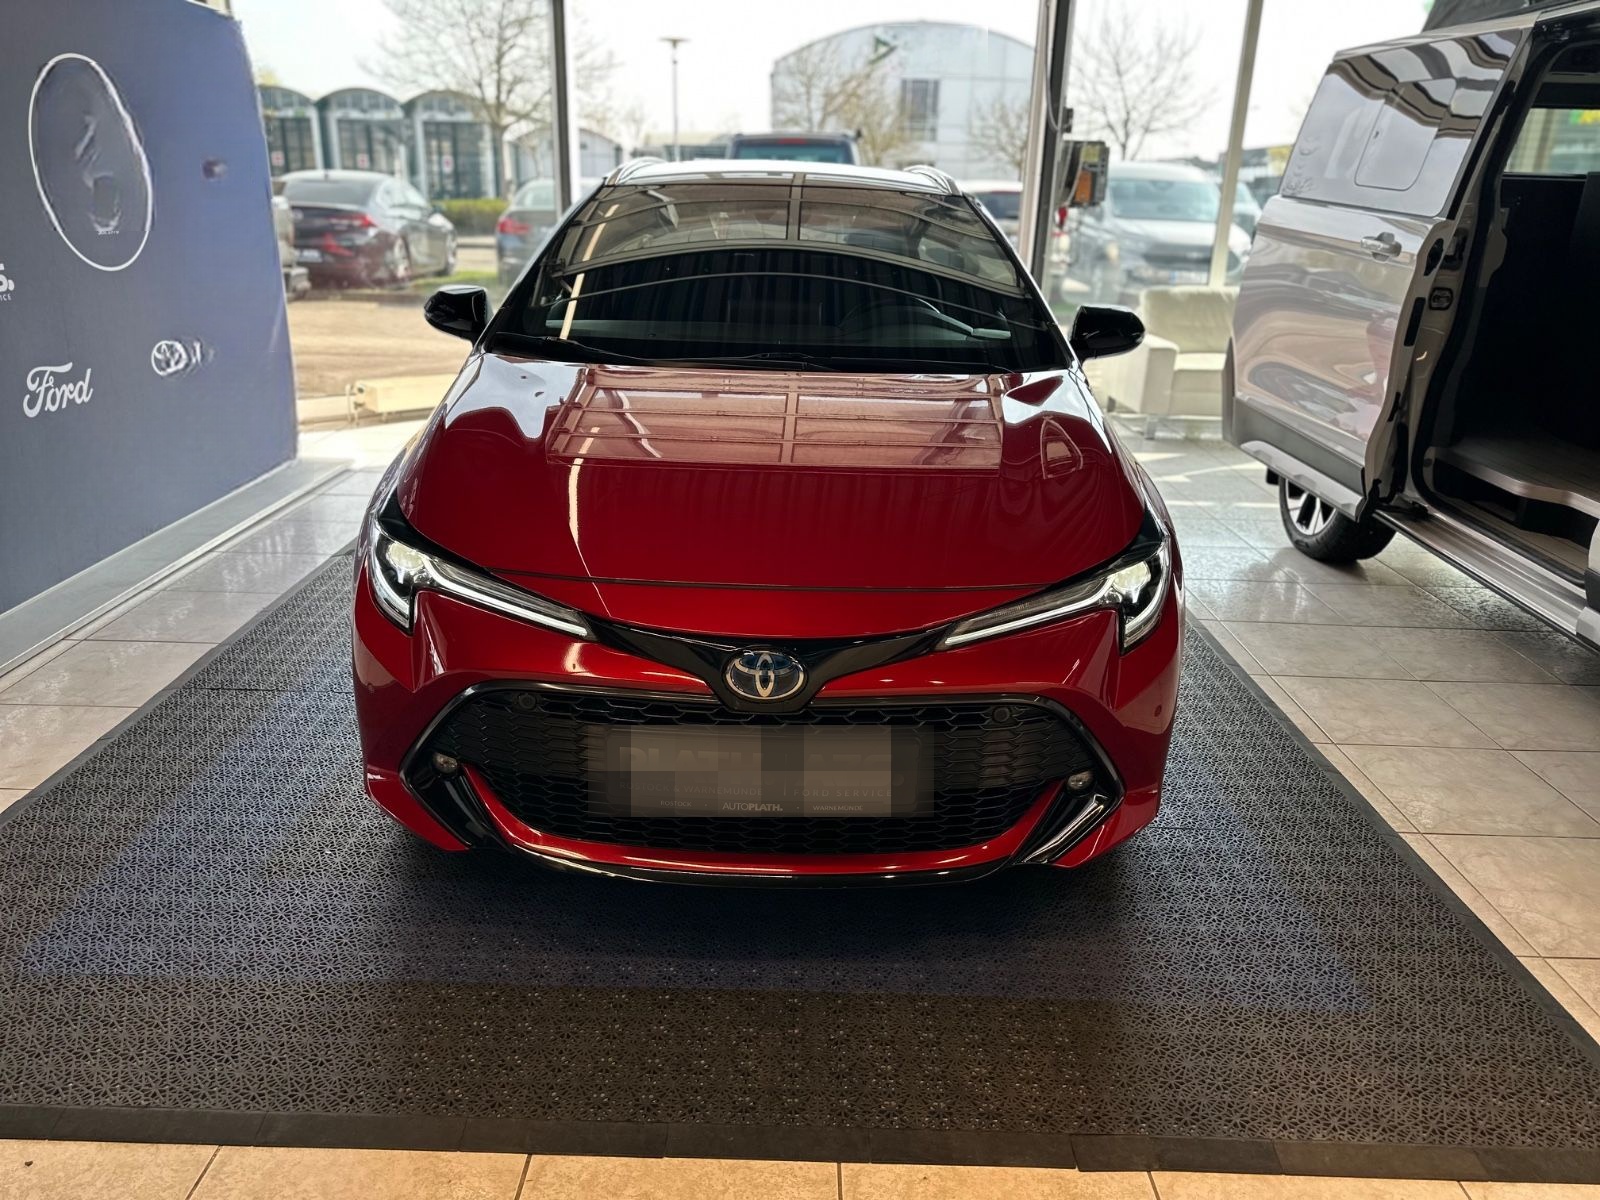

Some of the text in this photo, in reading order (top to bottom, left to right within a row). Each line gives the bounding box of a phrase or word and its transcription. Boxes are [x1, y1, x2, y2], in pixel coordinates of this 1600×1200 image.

[23, 361, 94, 418] Ford
[793, 789, 892, 798] FORD SERVICE
[660, 800, 692, 808] ROSTOCK
